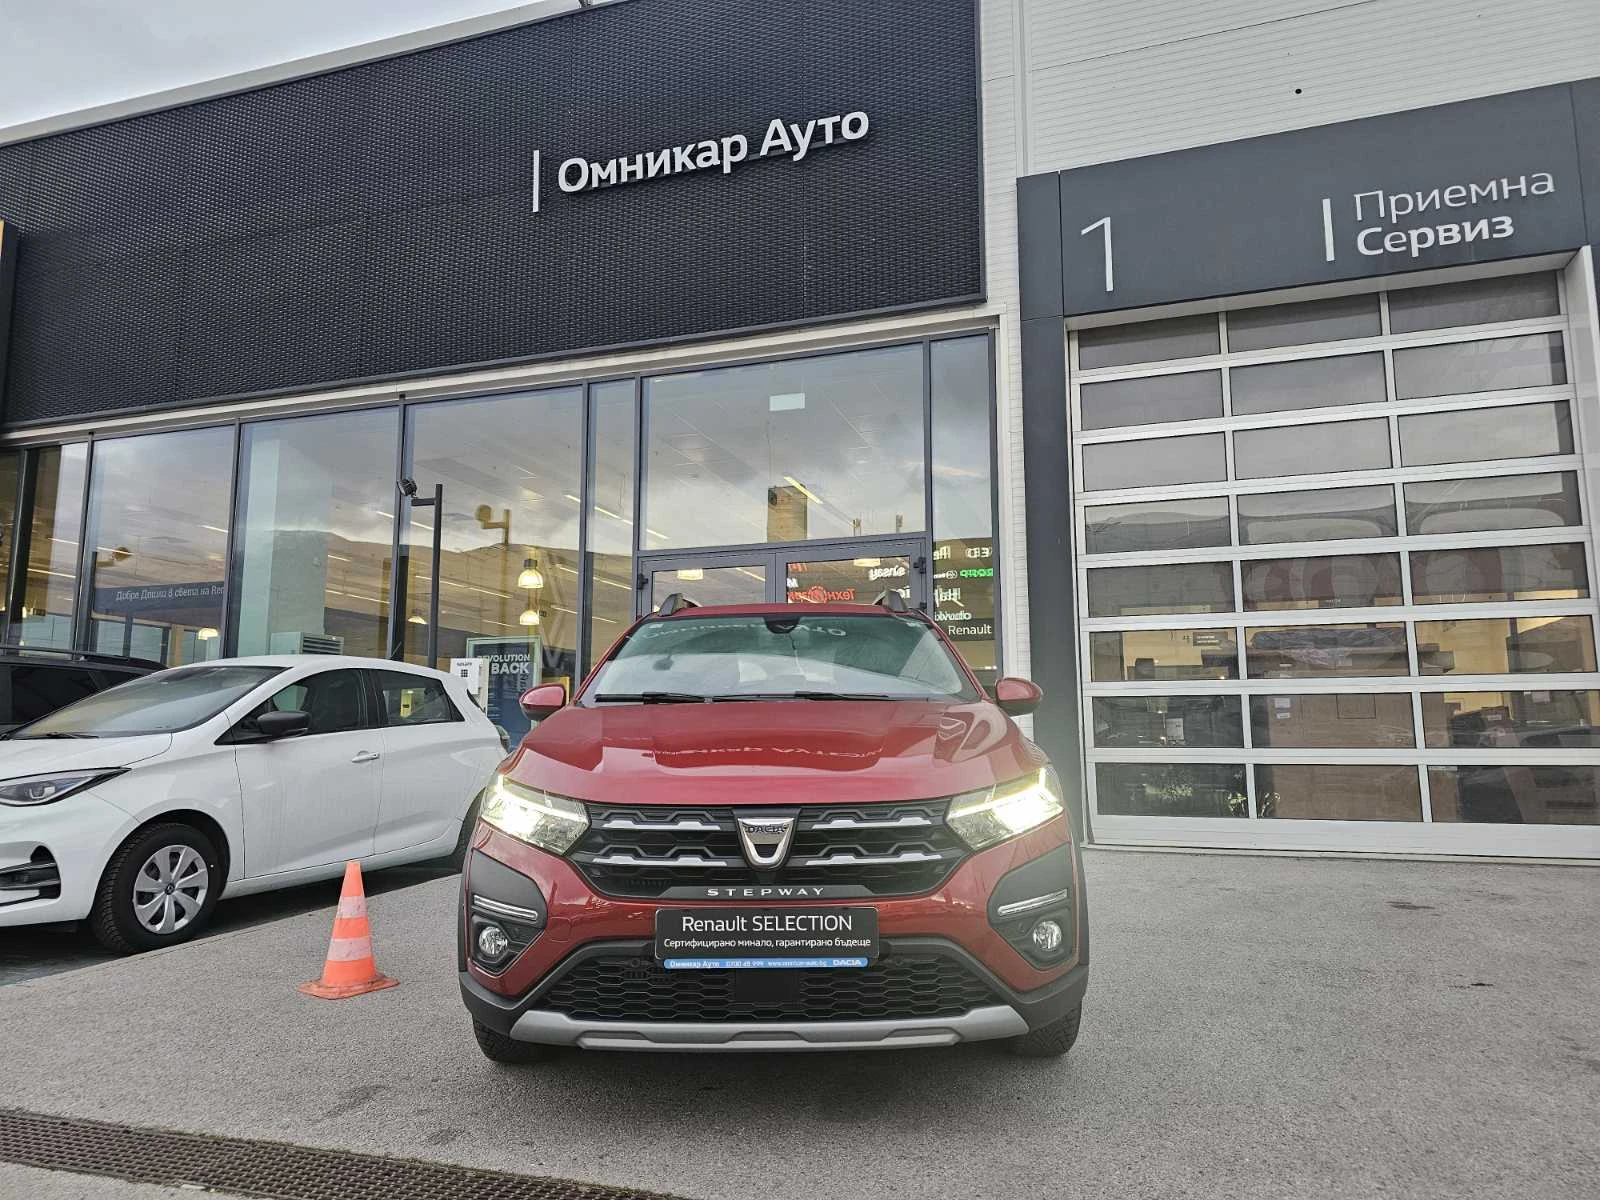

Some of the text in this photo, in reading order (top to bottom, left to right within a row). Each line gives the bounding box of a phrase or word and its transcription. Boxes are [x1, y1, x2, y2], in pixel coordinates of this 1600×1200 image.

[558, 111, 870, 193] Омникар Ауто
[1354, 172, 1555, 223] Приемна
[1356, 214, 1515, 257] Сервиз
[1080, 216, 1114, 292] 1
[948, 624, 992, 635] Renault
[491, 662, 529, 674] BACK
[747, 825, 785, 833] DACIA
[707, 887, 825, 896] STEPWAY
[682, 915, 852, 932] Renault SELECTION
[664, 937, 871, 949] Сертифицирано минало, гарантирано бъдеще
